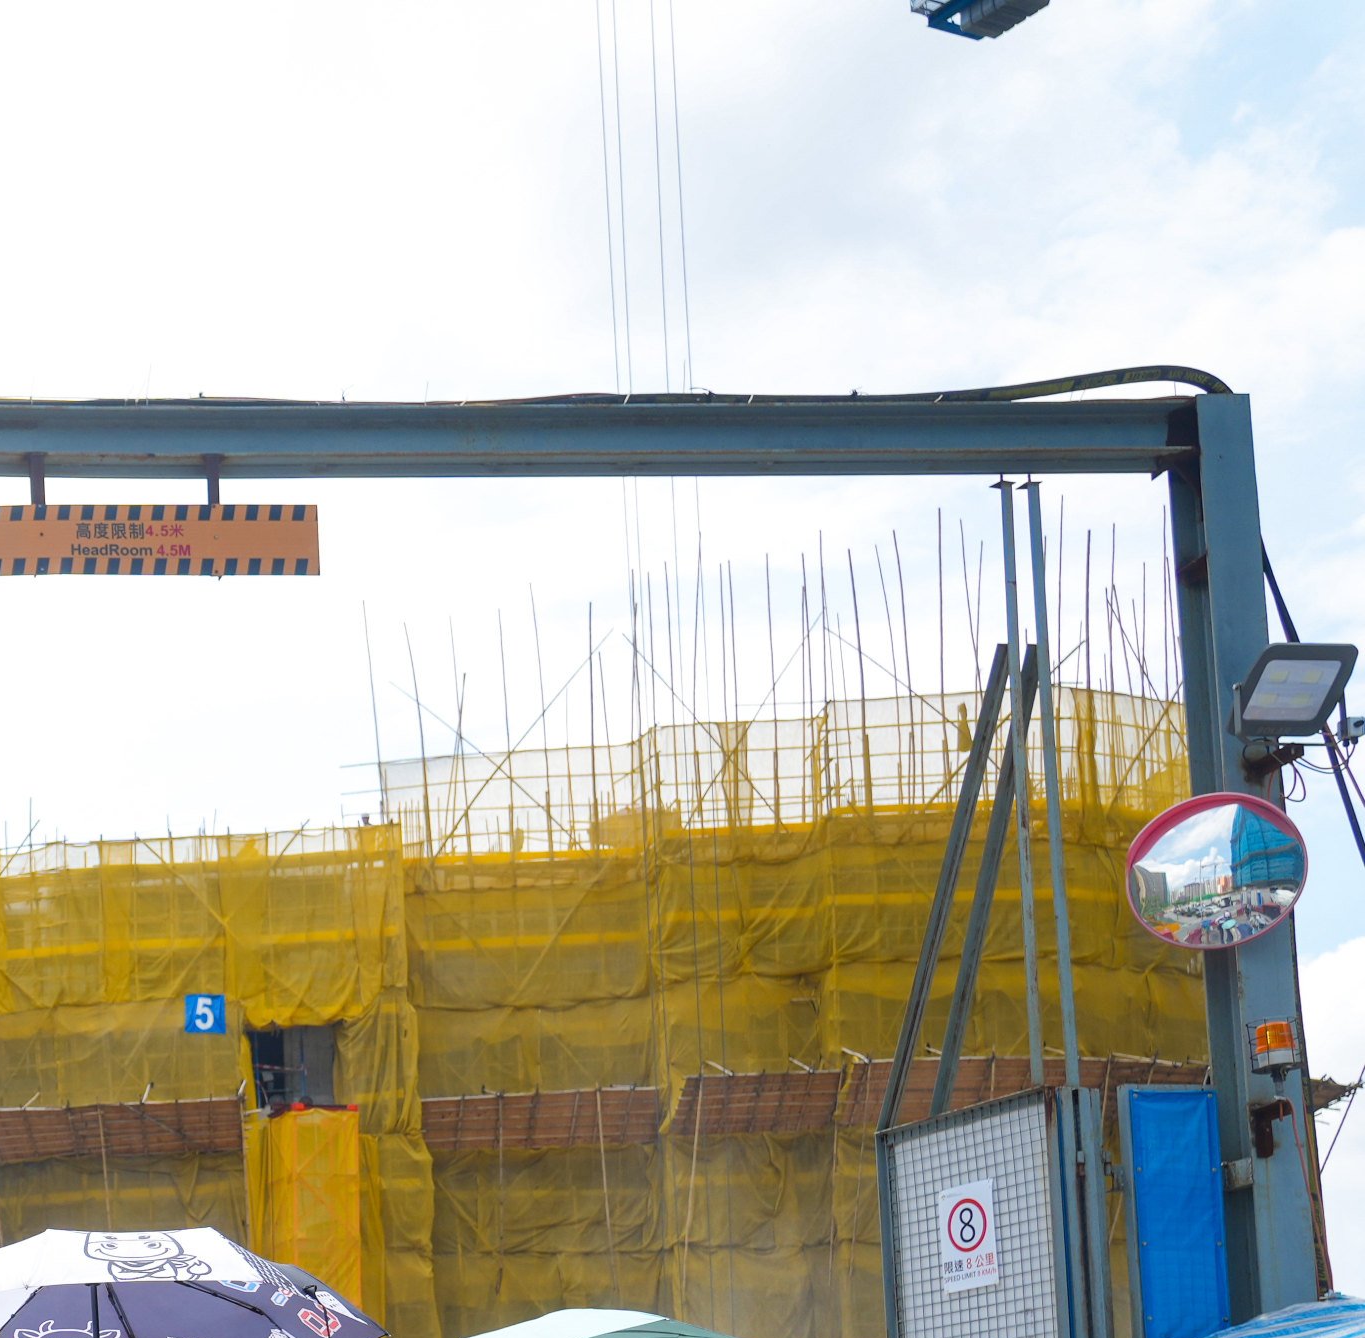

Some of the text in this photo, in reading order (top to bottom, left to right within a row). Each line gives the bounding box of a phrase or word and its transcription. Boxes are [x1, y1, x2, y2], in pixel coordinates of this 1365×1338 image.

[75, 522, 184, 540] 高度限制4.5米
[71, 544, 191, 557] HeadRoom 4.5M
[195, 997, 214, 1030] 5
[959, 1207, 976, 1243] 8
[966, 1257, 973, 1270] 8
[975, 1252, 995, 1268] 公里
[961, 1271, 976, 1281] LIMIT
